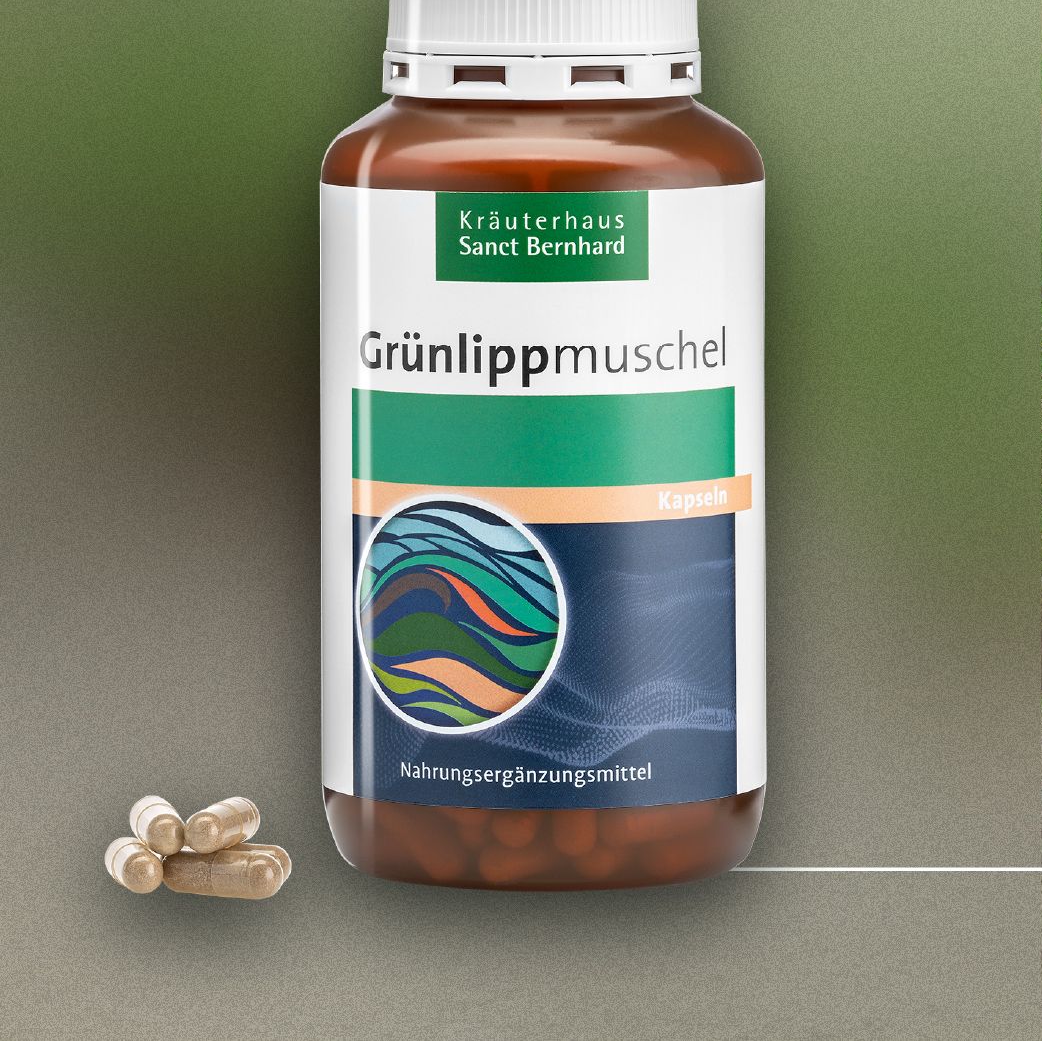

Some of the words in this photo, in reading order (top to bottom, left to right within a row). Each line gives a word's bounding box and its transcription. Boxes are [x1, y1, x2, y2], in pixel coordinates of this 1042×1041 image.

[459, 209, 626, 231] Kräuterhaus
[459, 235, 520, 257] Sanct
[527, 234, 626, 257] Bernhard
[359, 325, 727, 388] Grünlippmuschel
[657, 485, 728, 515] Kapseln
[400, 760, 653, 789] Nahrungsergänzungsmittel
